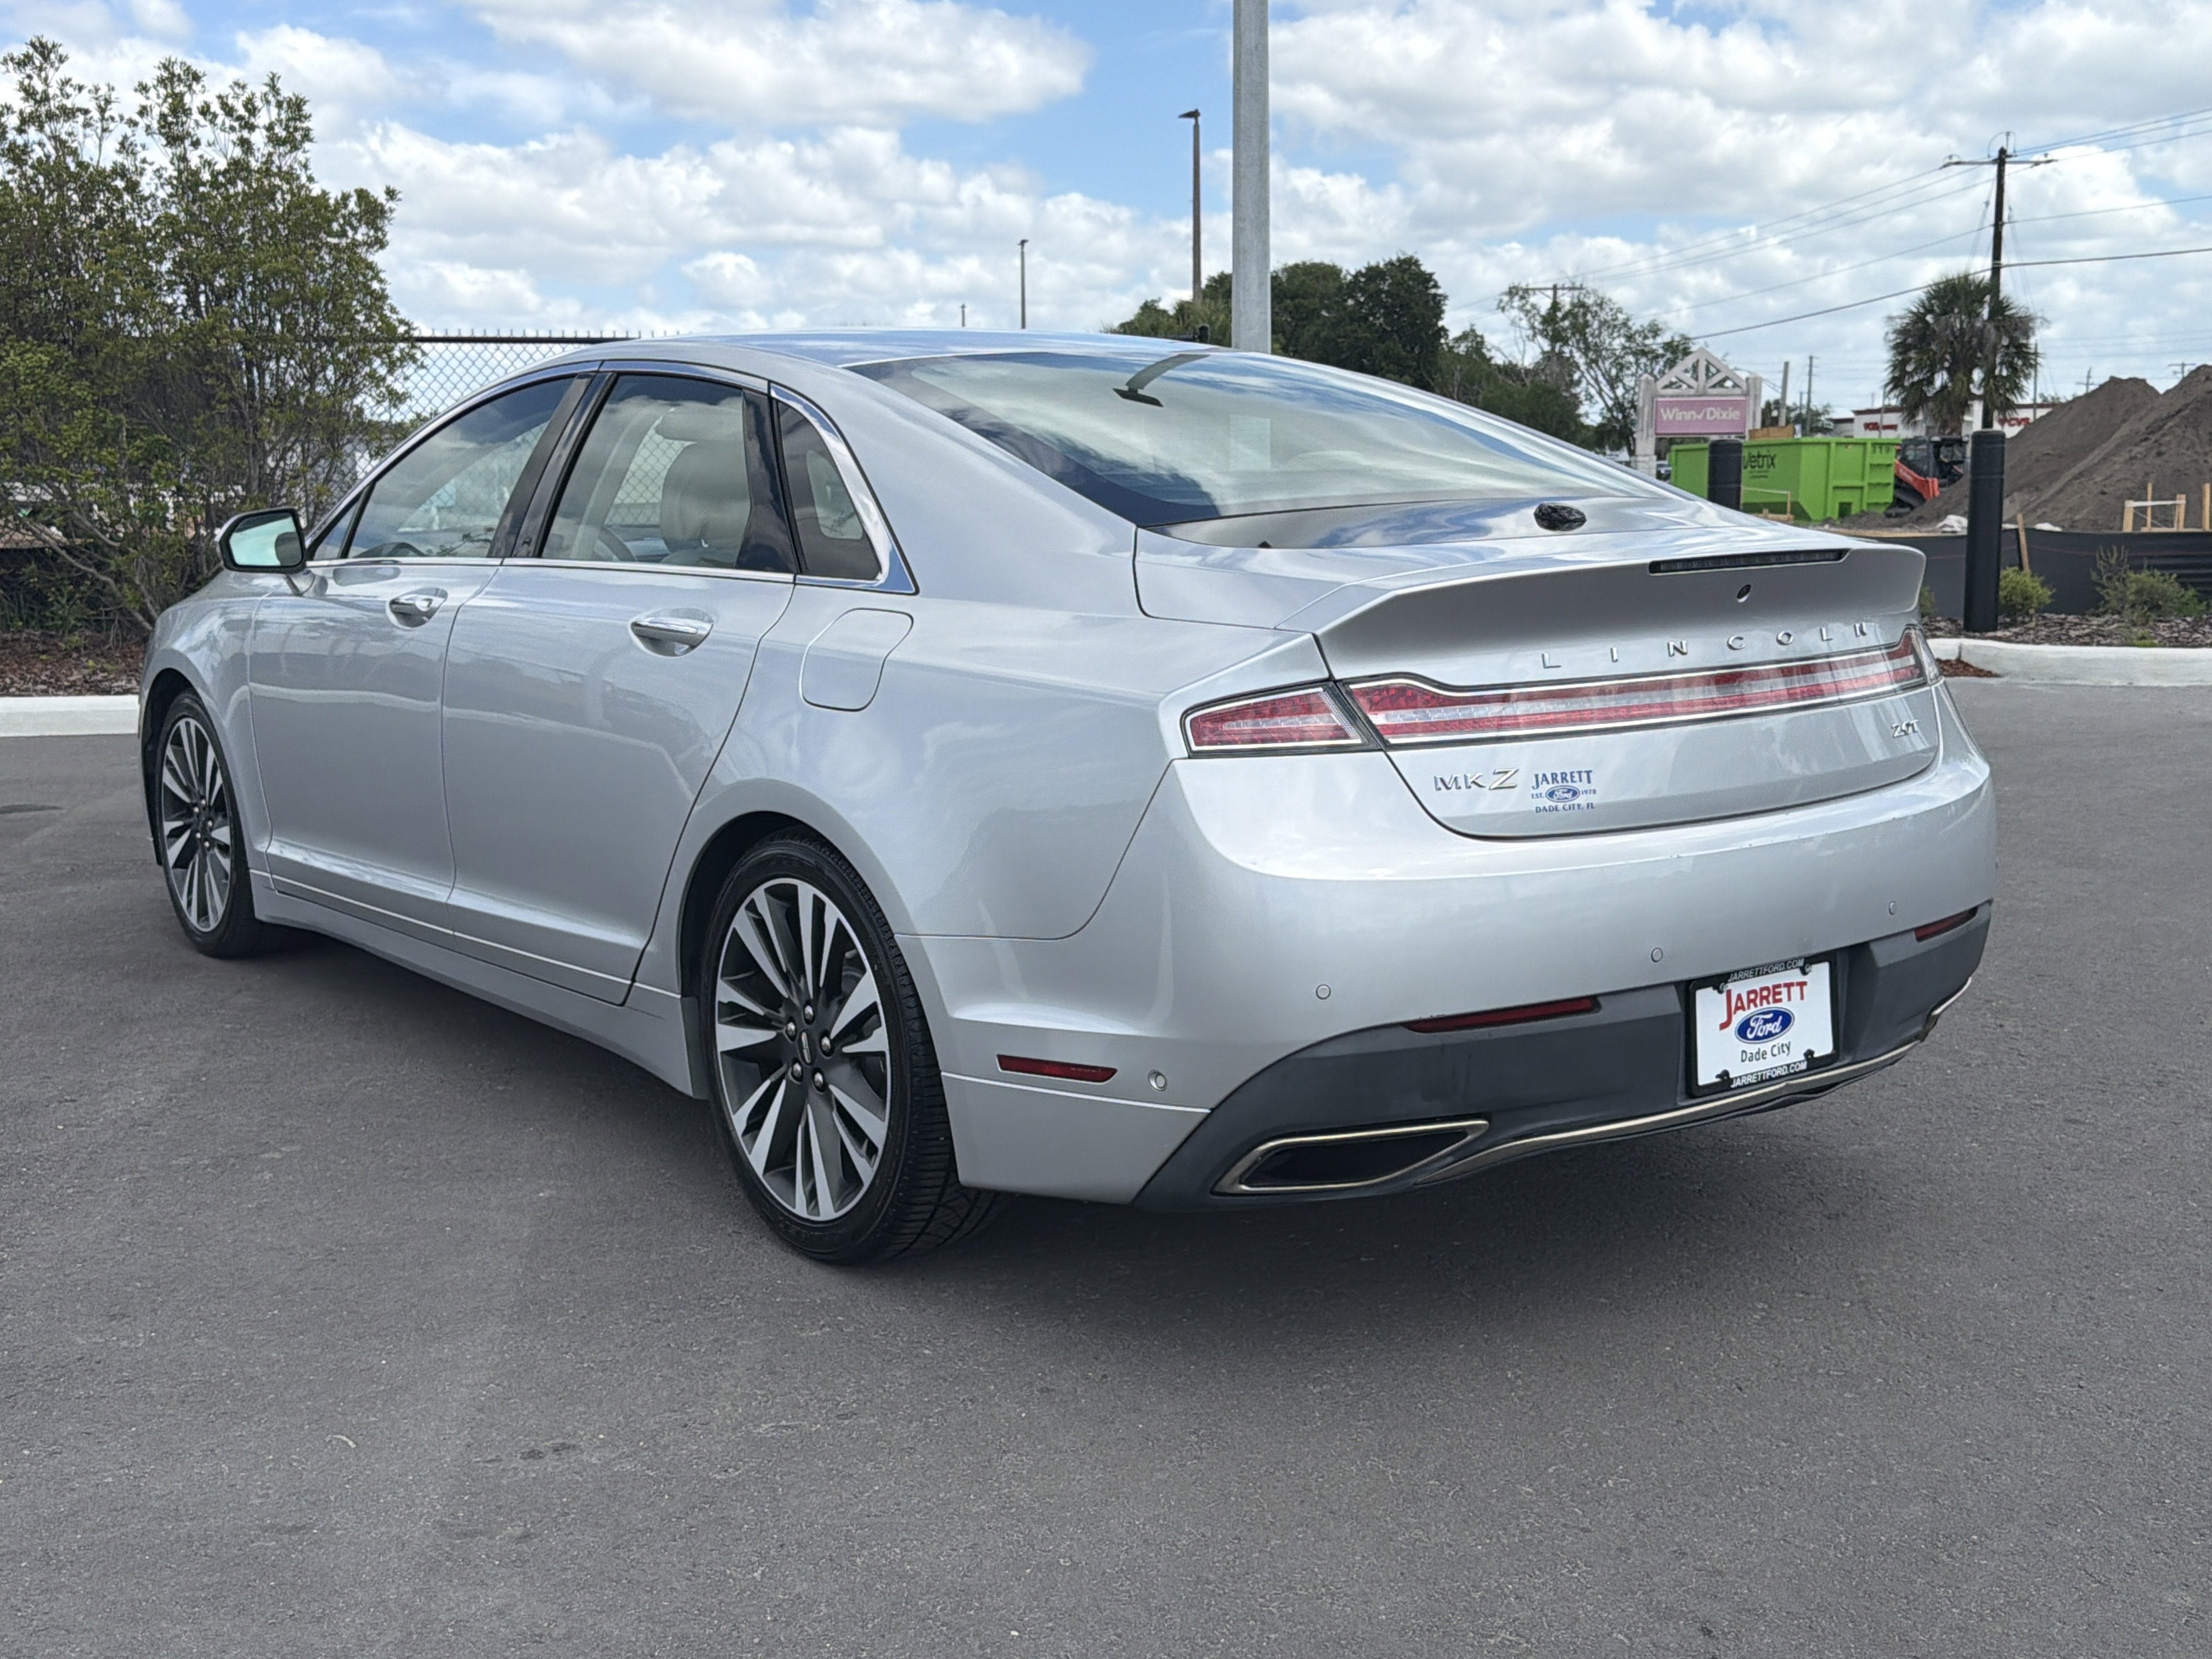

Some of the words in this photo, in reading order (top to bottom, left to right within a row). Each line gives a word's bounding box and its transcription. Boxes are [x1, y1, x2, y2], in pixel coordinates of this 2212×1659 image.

[1542, 622, 1867, 669] LINCOLN
[1434, 768, 1519, 791] MKZ
[1532, 770, 1592, 789] JARRETT
[1536, 805, 1559, 813] DADE
[1728, 958, 1804, 982] JARRETTFORD.COM
[1719, 981, 1807, 1031] JARRETT
[1741, 1047, 1767, 1063] Dade
[1771, 1041, 1791, 1058] City
[1730, 1060, 1807, 1088] JARRETTFORD.COM
